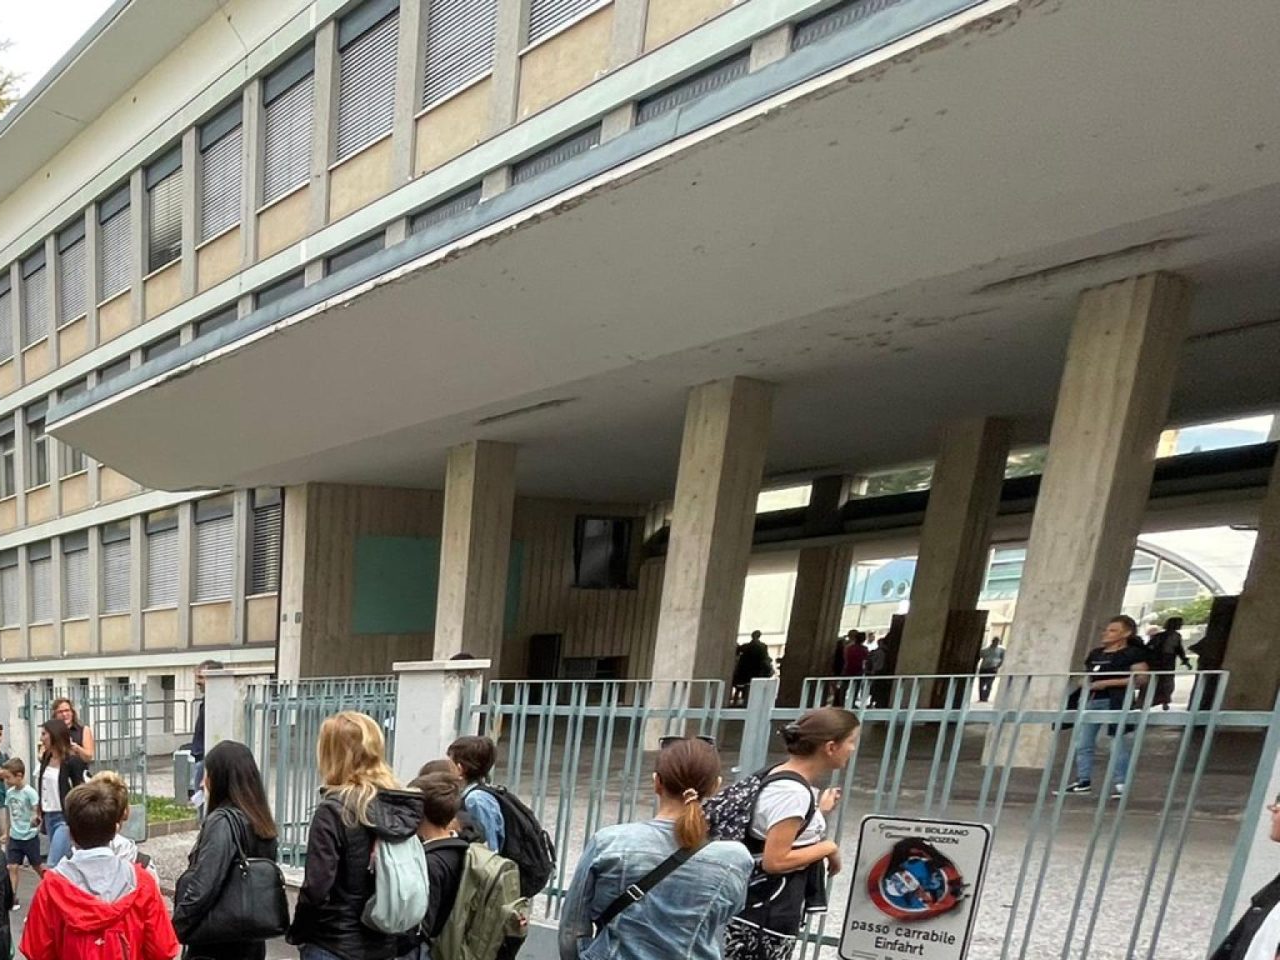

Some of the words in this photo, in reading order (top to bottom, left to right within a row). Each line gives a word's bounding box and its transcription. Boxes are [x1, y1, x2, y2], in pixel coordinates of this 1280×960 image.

[924, 826, 969, 836] BOLZANO
[851, 920, 890, 935] passo
[894, 928, 956, 945] carrabile
[874, 936, 925, 956] Einfahrt
